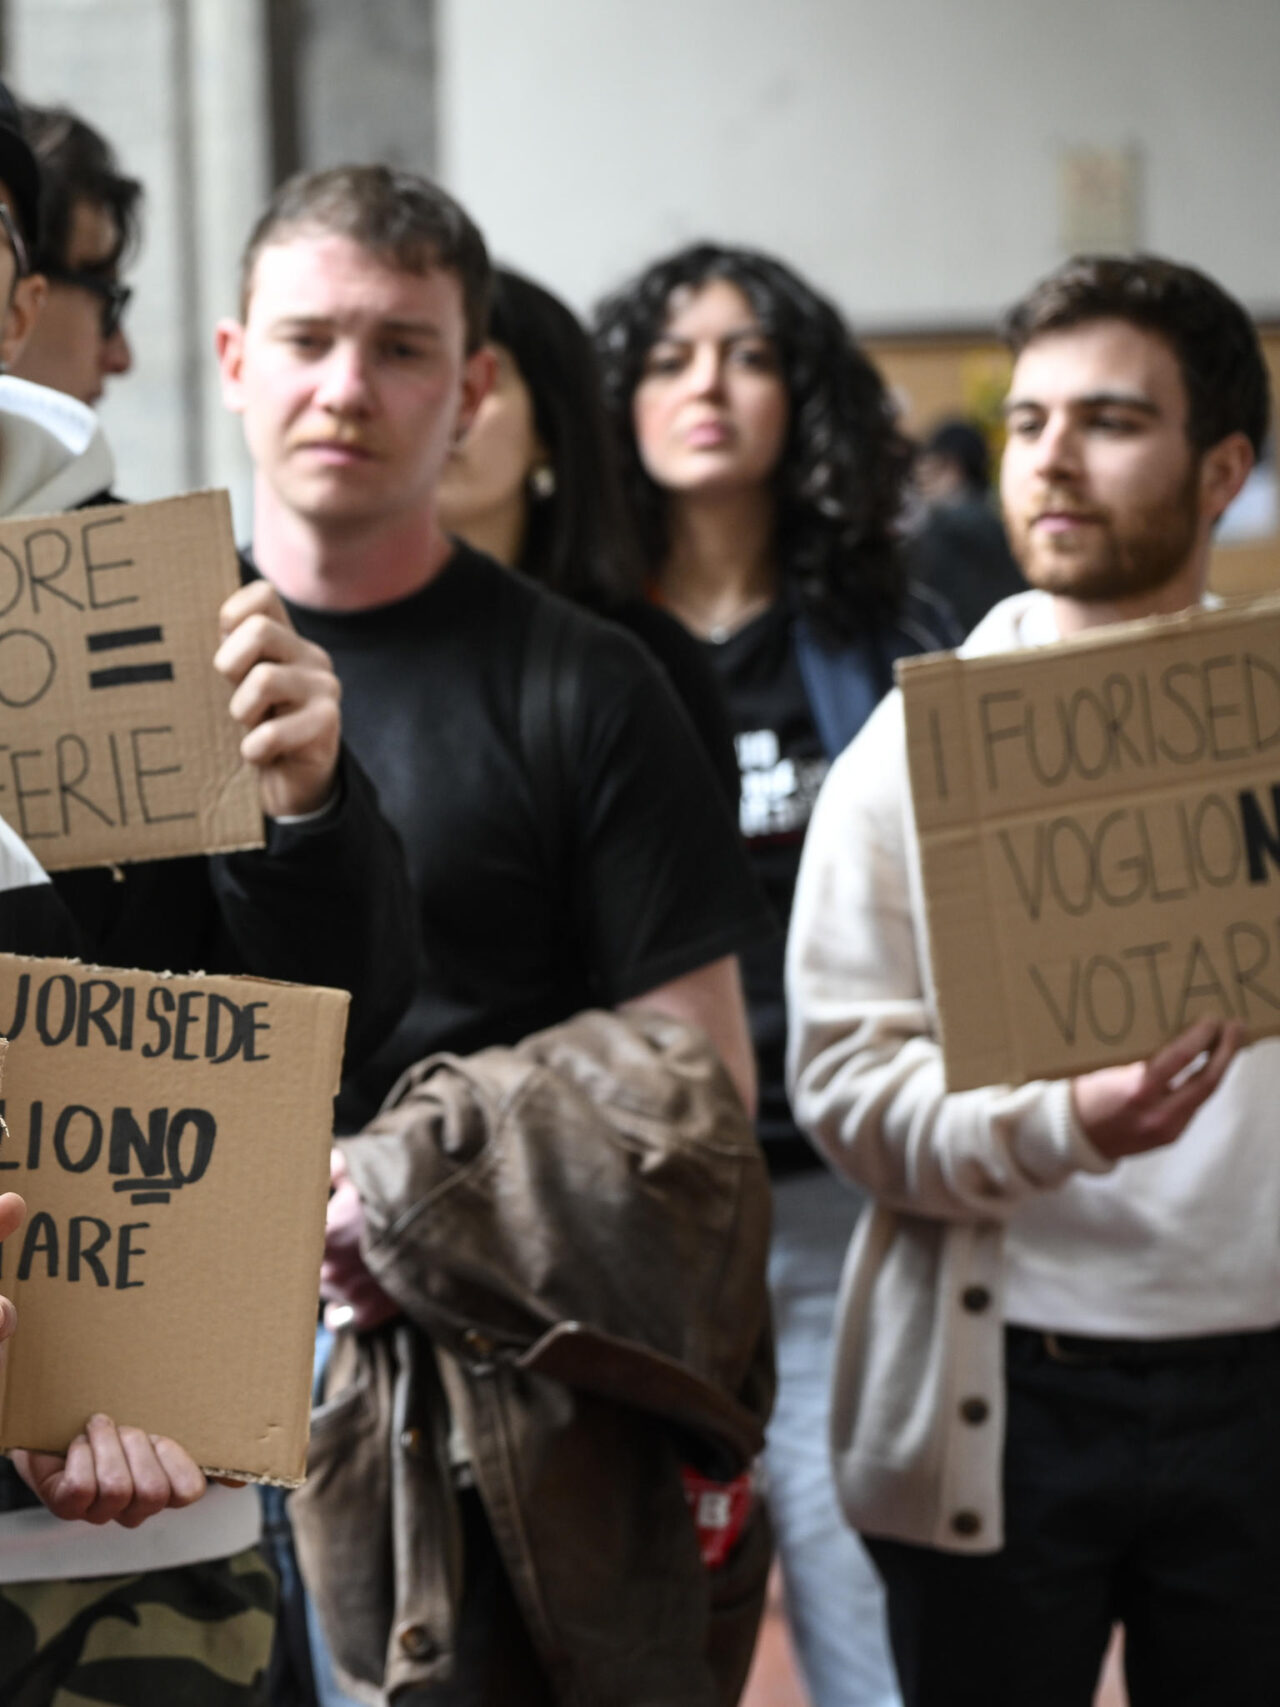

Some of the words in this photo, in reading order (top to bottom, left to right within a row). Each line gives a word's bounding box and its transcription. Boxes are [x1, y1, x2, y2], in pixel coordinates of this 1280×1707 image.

[928, 709, 950, 799] I
[979, 653, 1280, 790] FUORISED
[1028, 914, 1280, 1048] VOTAR
